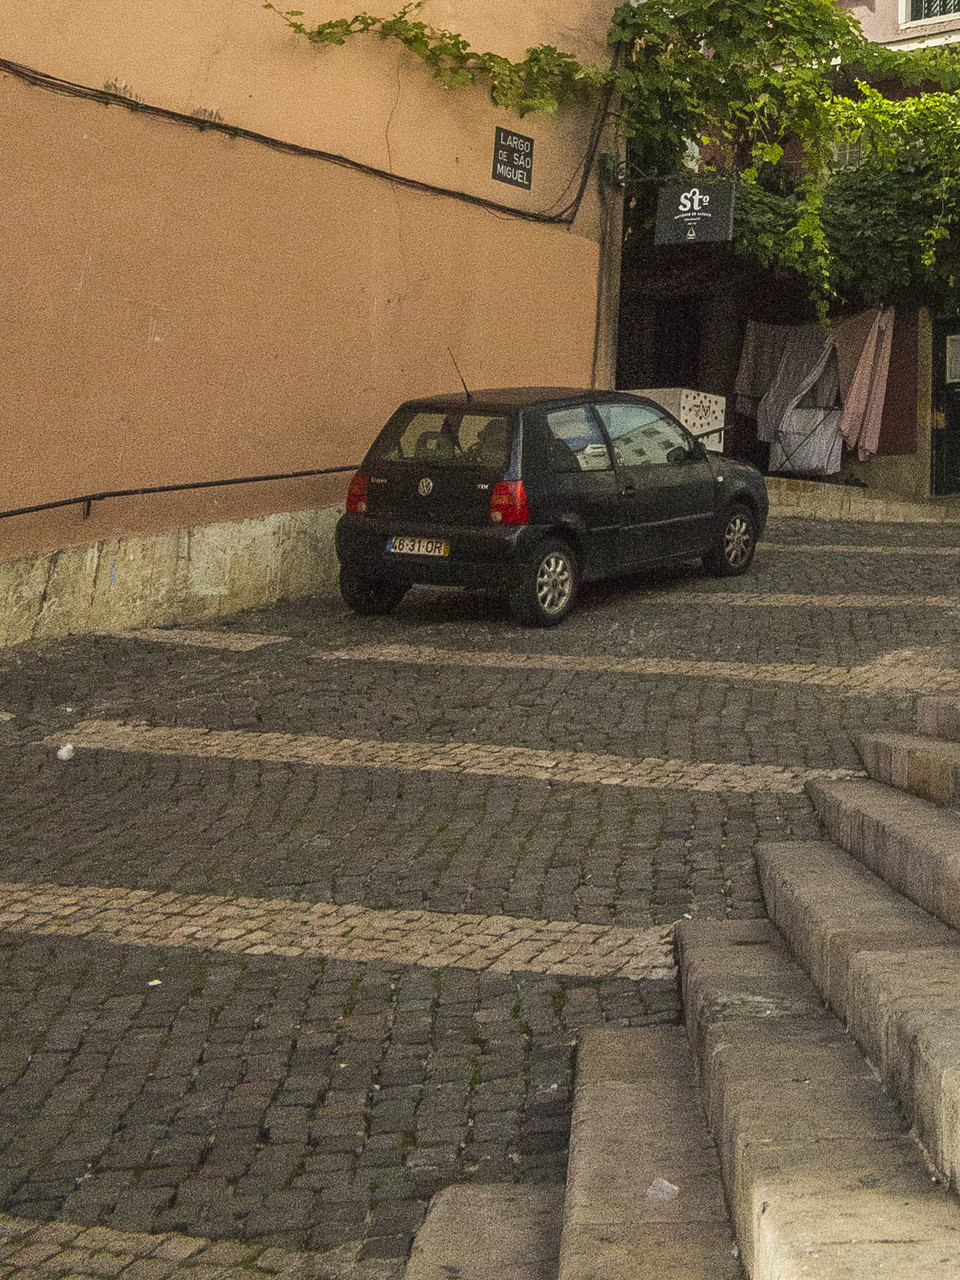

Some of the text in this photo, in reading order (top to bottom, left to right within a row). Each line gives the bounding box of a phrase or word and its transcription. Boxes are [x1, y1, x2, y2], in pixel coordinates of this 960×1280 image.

[500, 131, 530, 153] LARGO
[498, 149, 508, 162] DE
[497, 162, 529, 184] MIGUEL
